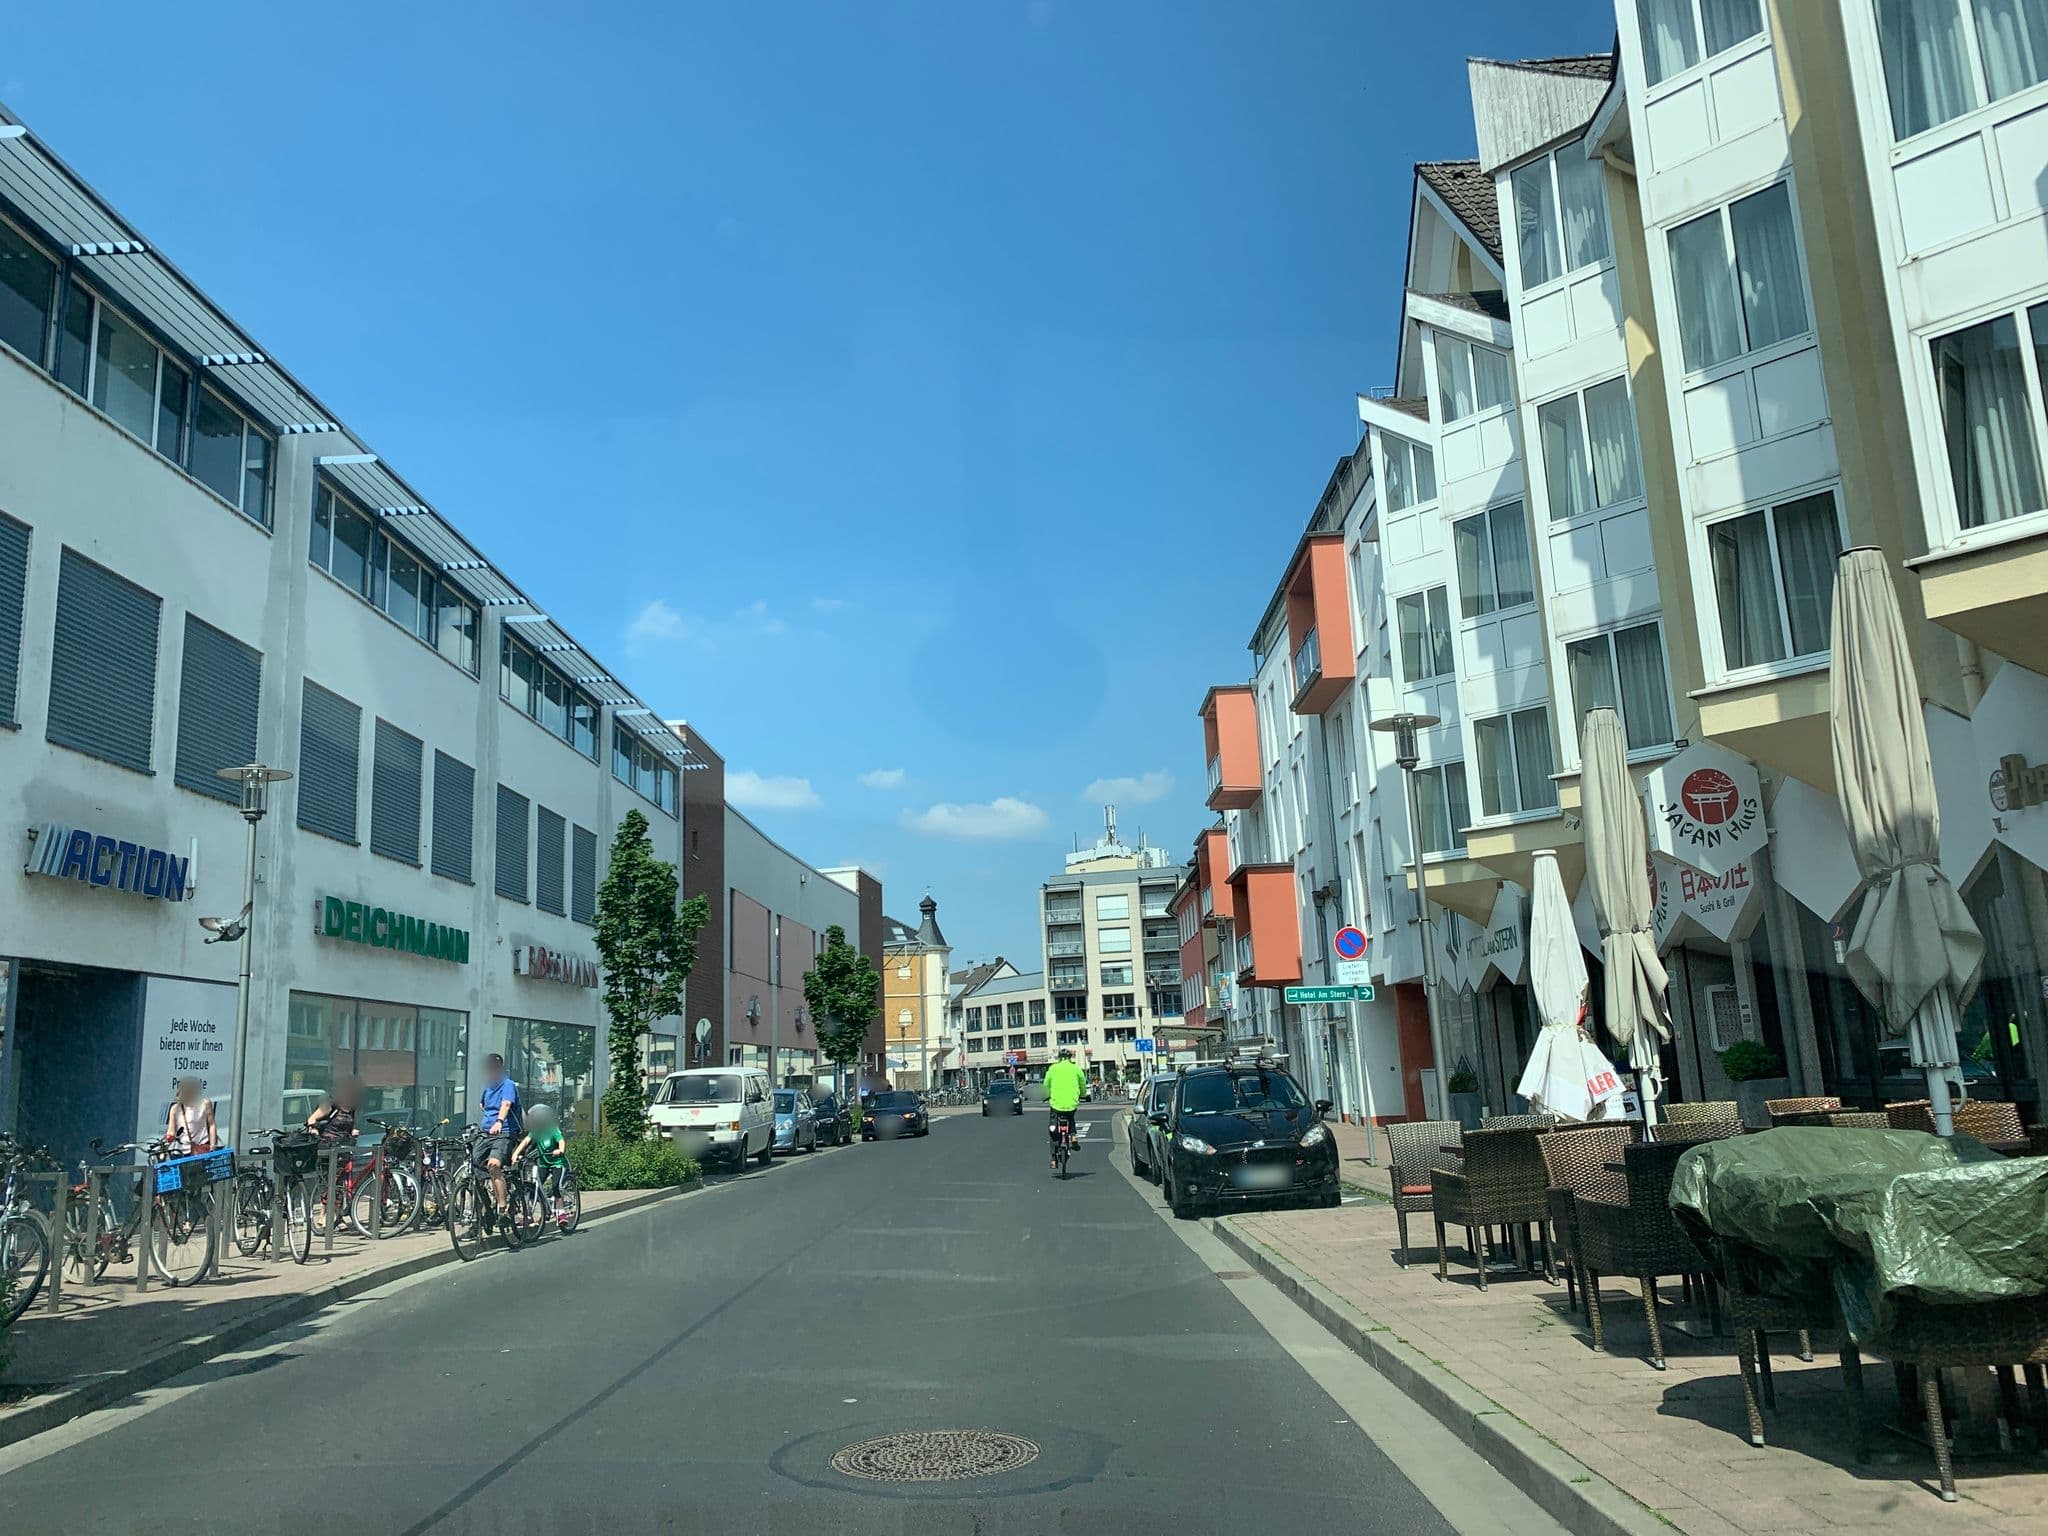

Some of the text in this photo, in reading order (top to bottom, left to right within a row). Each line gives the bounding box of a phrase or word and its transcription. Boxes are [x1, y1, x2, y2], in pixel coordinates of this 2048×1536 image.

[1659, 802, 1721, 848] JAPAN
[61, 829, 188, 901] ACTION
[325, 896, 469, 964] DEICHMANN
[1494, 925, 1518, 953] STERN
[1300, 990, 1346, 999] Hotel Am Stern
[170, 1018, 216, 1034] Jede Woche
[159, 1036, 223, 1052] bieten wir Ihnen
[174, 1057, 209, 1070] 150 neue
